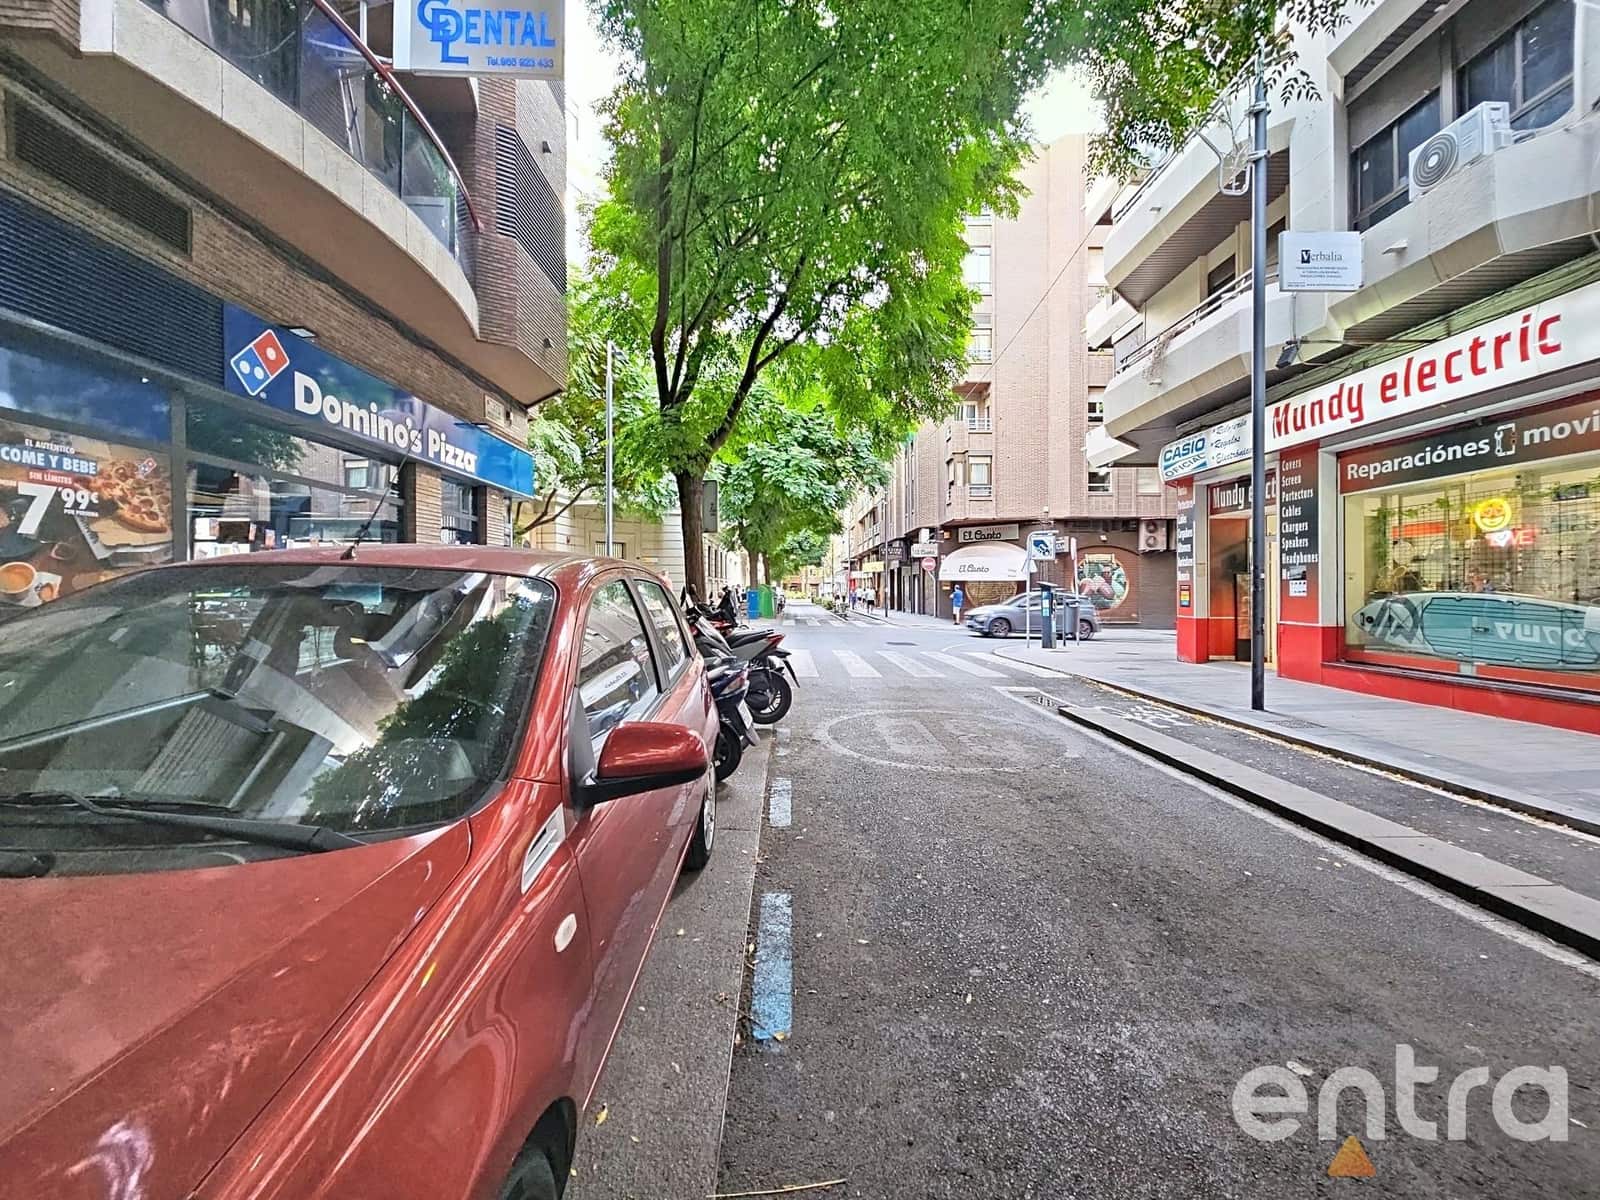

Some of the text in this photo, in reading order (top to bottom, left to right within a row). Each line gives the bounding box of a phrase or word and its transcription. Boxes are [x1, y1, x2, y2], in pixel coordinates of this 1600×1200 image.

[1301, 249, 1343, 264] Verbalia
[1273, 313, 1562, 438] Mundy electric
[294, 371, 422, 453] Domino's
[428, 429, 477, 473] Pizza
[25, 439, 33, 447] EL
[1164, 437, 1205, 463] CASIO
[1, 447, 97, 474] COME Y BEBE
[1165, 453, 1206, 477] OFICIAL
[1282, 459, 1301, 472] Covers
[1347, 437, 1490, 480] Reparaciónes
[1282, 475, 1301, 487] Screen
[1213, 484, 1245, 509] Mundy
[1282, 521, 1308, 535] Chargers
[1282, 537, 1308, 551] Speakers
[1282, 552, 1319, 566] Headphones
